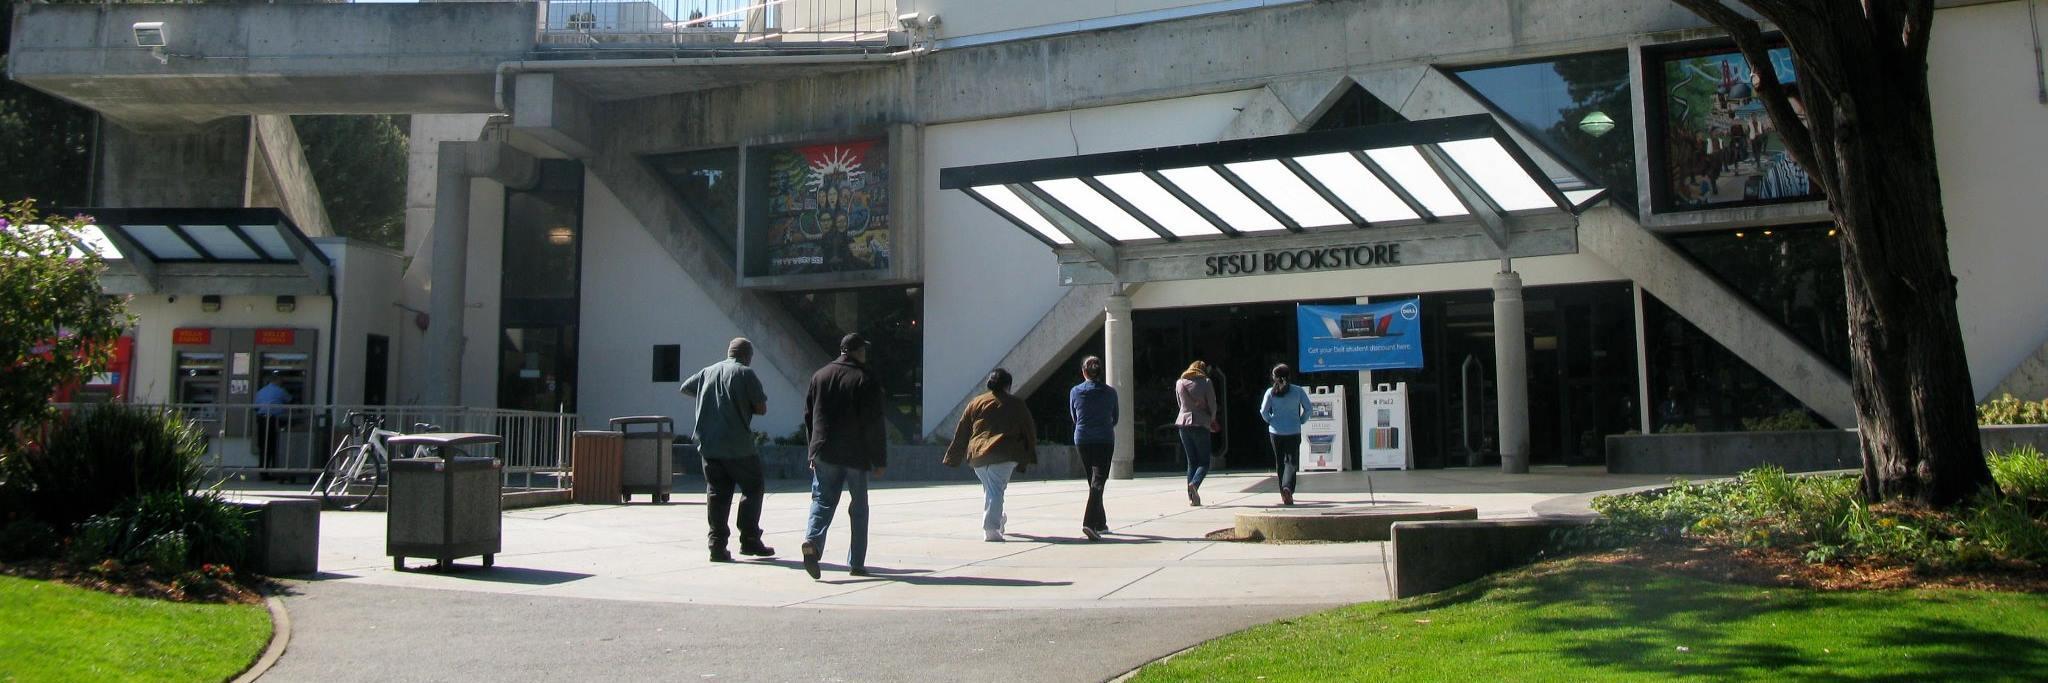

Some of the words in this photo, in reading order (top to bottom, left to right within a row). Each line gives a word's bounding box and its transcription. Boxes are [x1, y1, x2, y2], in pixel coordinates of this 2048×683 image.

[1205, 253, 1257, 276] SFSU
[1263, 243, 1401, 272] BOOKSTORE
[1319, 347, 1333, 355] your
[1333, 345, 1345, 353] Dell
[1345, 345, 1369, 353] student
